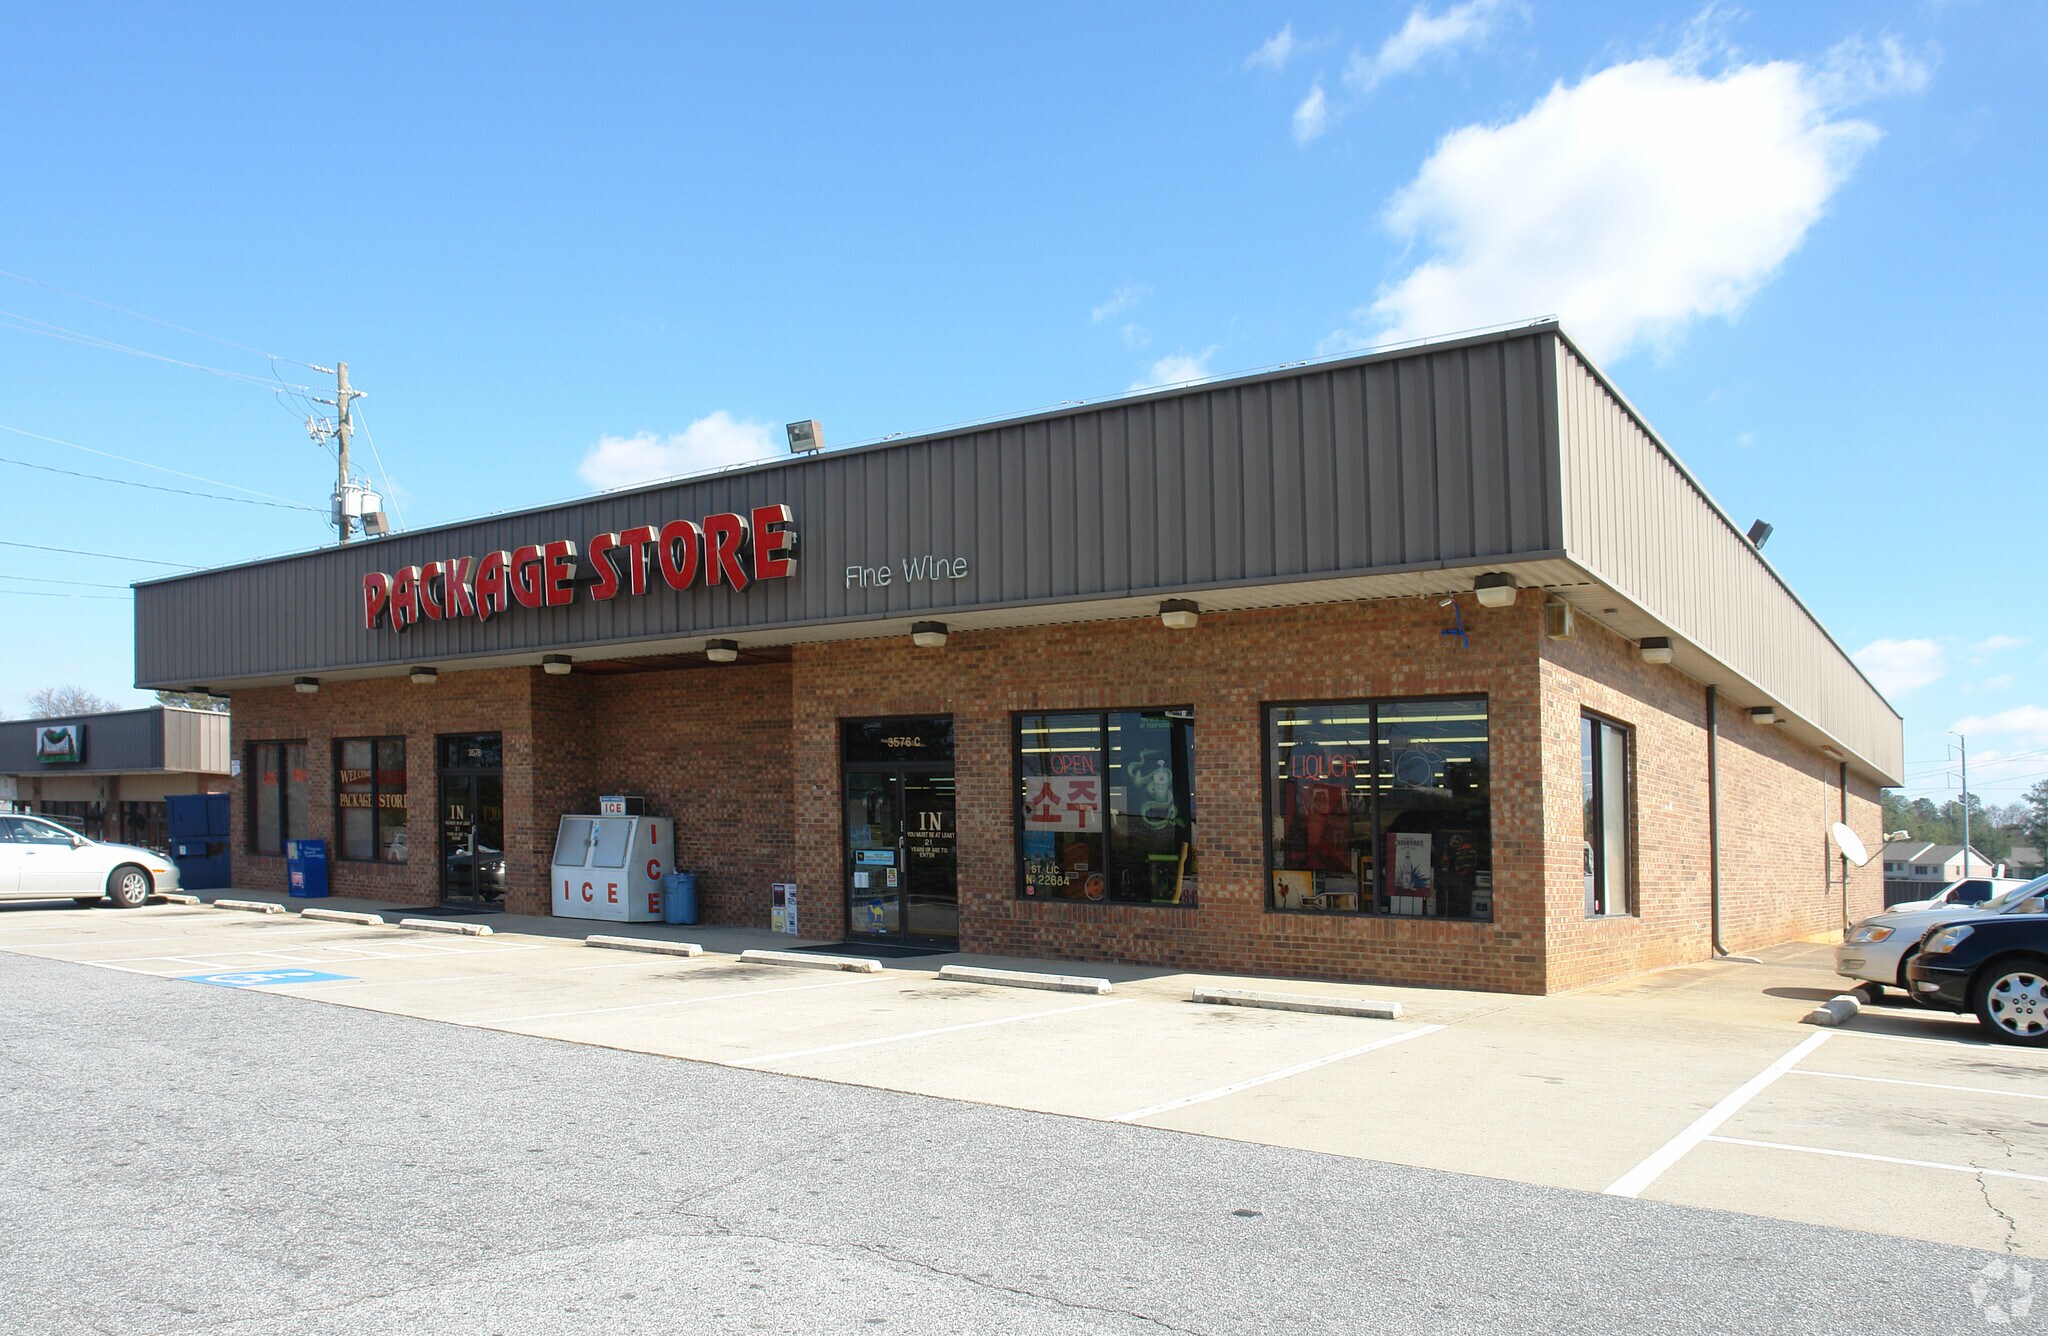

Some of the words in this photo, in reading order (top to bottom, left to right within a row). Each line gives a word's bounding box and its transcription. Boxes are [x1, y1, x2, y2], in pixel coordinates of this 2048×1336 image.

[363, 540, 577, 633] PACKAGE
[589, 504, 797, 600] STORE
[1050, 754, 1095, 775] OPEN
[1292, 754, 1358, 781] LIQUOR
[450, 805, 464, 820] IN
[605, 803, 622, 813] ICE
[1031, 780, 1098, 828] 소주
[919, 811, 943, 831] IN
[924, 838, 933, 846] 21
[647, 824, 661, 914] ICE
[1038, 875, 1070, 886] 22684
[564, 880, 618, 904] ICE
